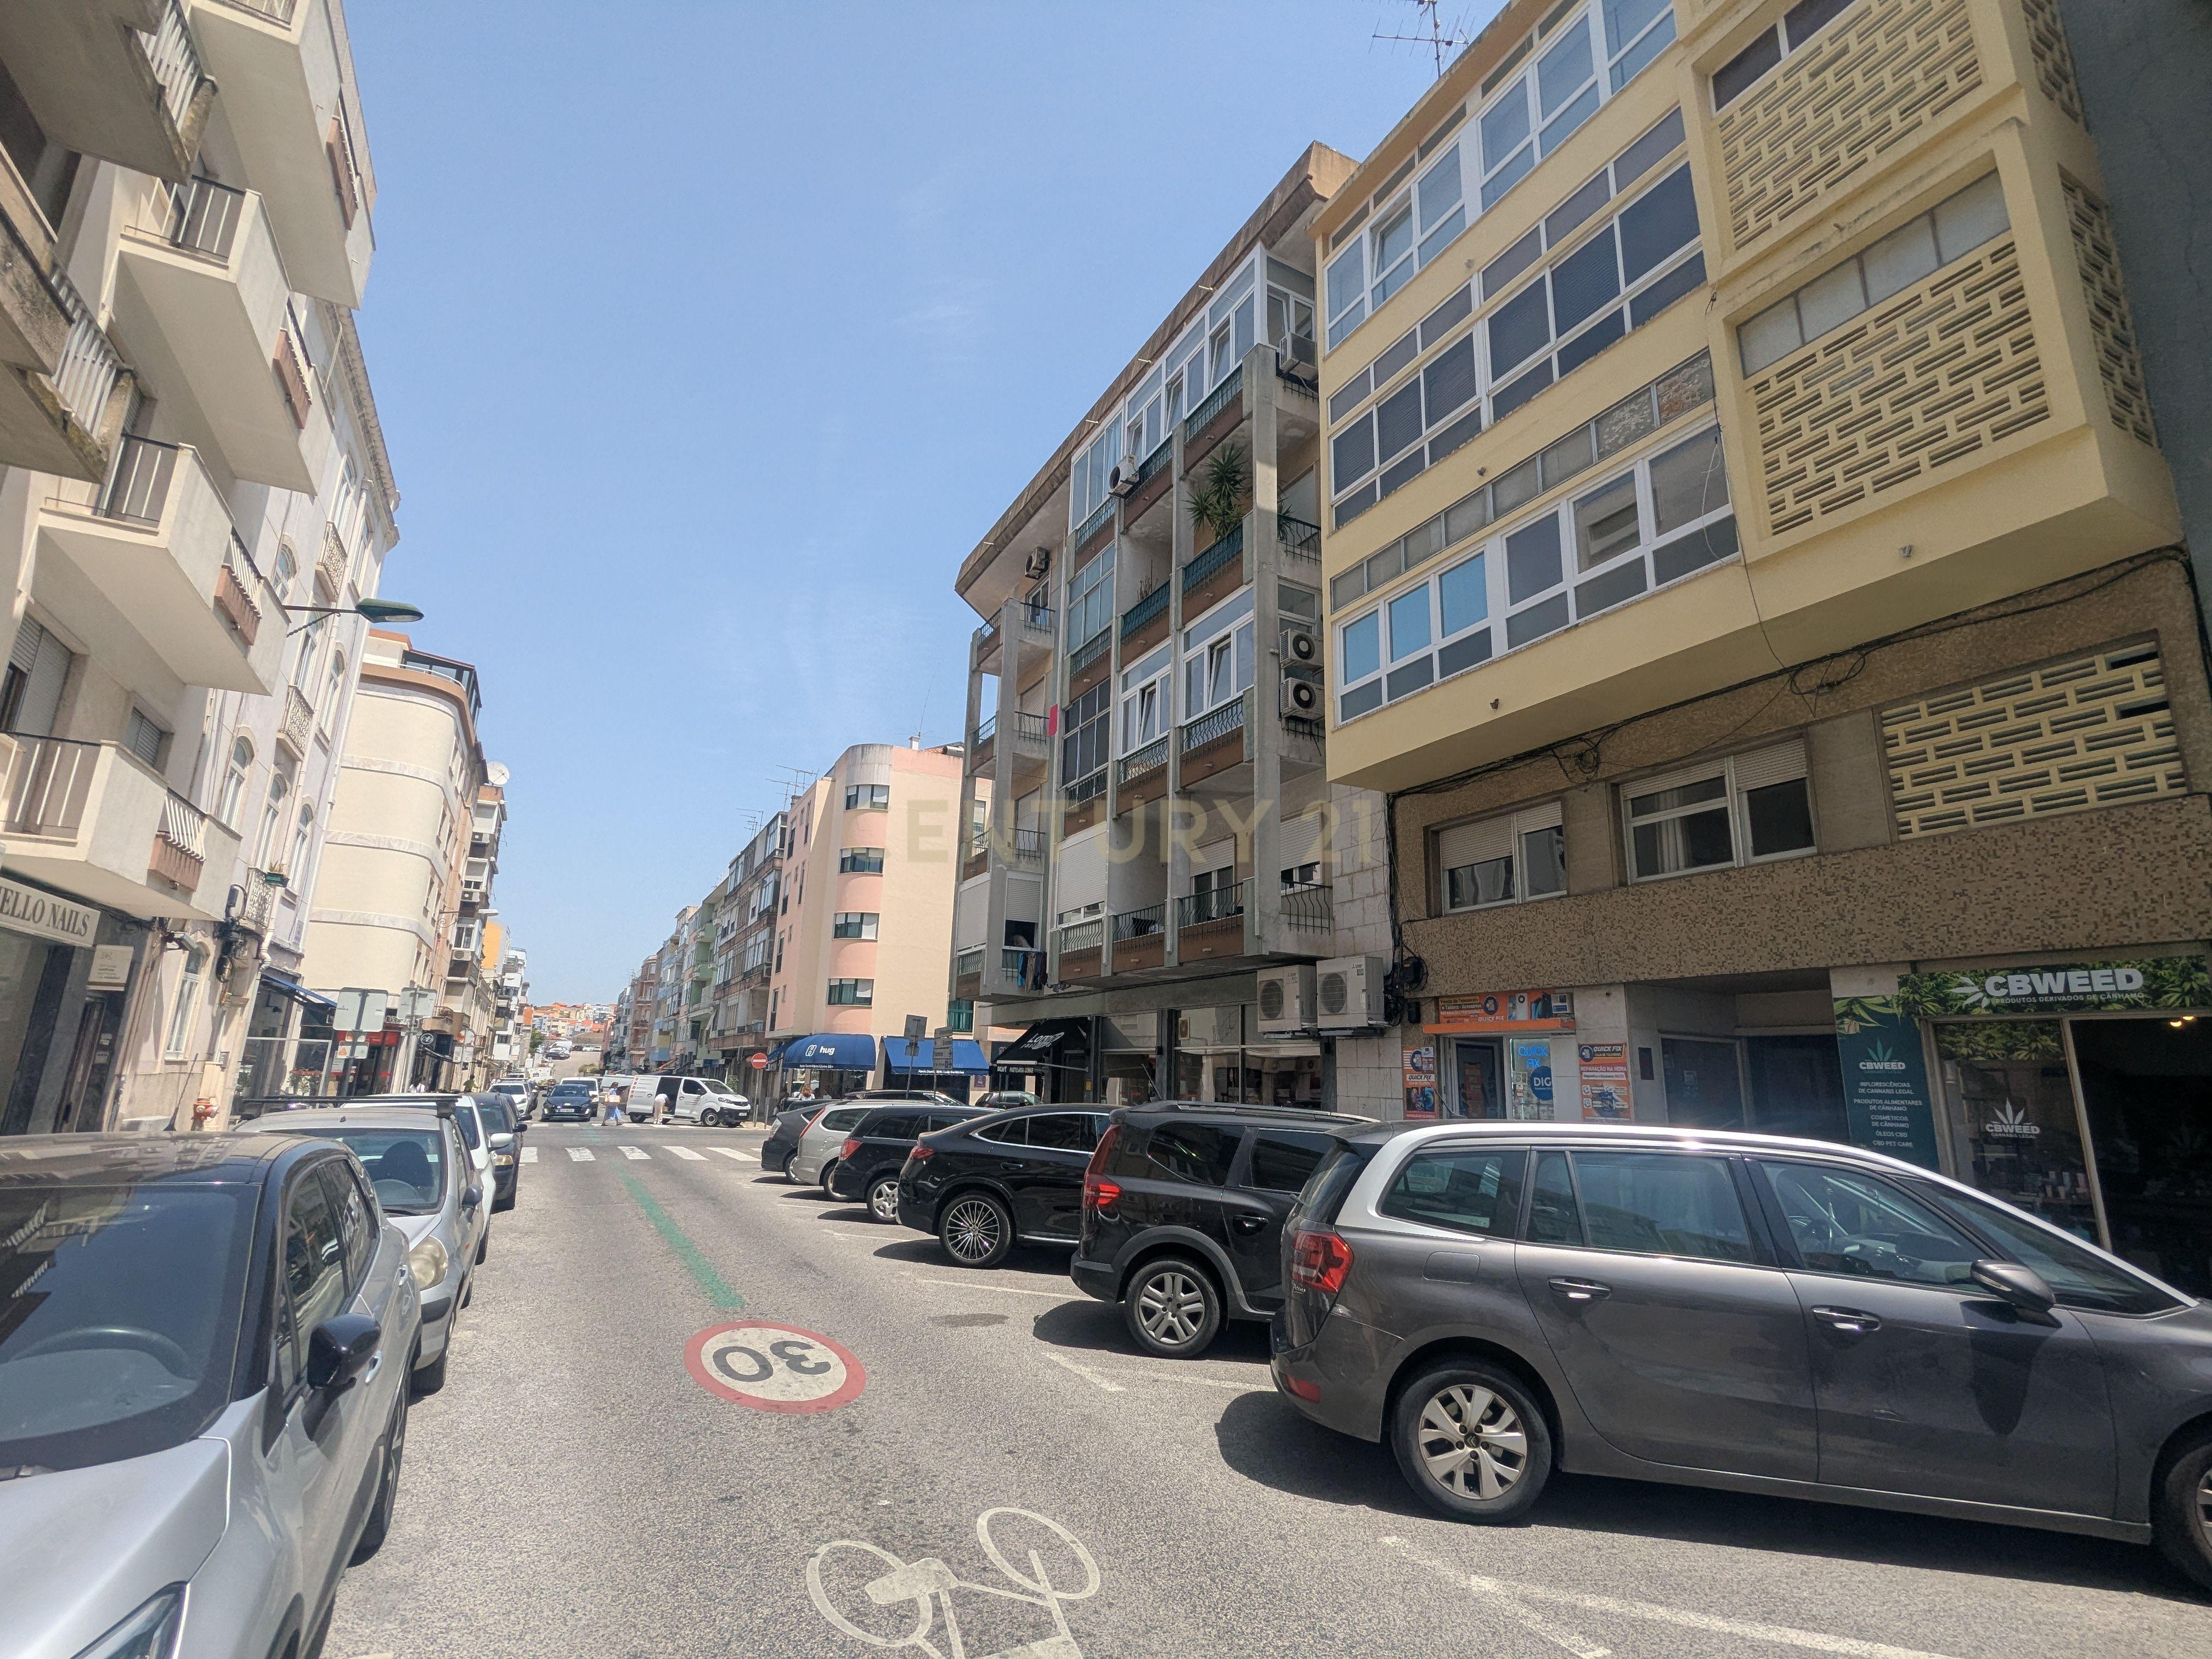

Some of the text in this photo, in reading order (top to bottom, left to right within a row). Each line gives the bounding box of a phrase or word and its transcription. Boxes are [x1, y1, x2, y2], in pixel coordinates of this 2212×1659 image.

[46, 903, 90, 936] NAILS
[1985, 968, 2144, 997] CBWEED
[2039, 994, 2085, 1003] DERIVADOS
[2100, 991, 2145, 1001] CÂNHAMO
[819, 1046, 836, 1056] hug
[1518, 1046, 1549, 1056] QUICK
[1859, 1062, 1906, 1070] CBWEED
[1985, 1124, 2040, 1134] CBWEED
[713, 1340, 832, 1383] 30
